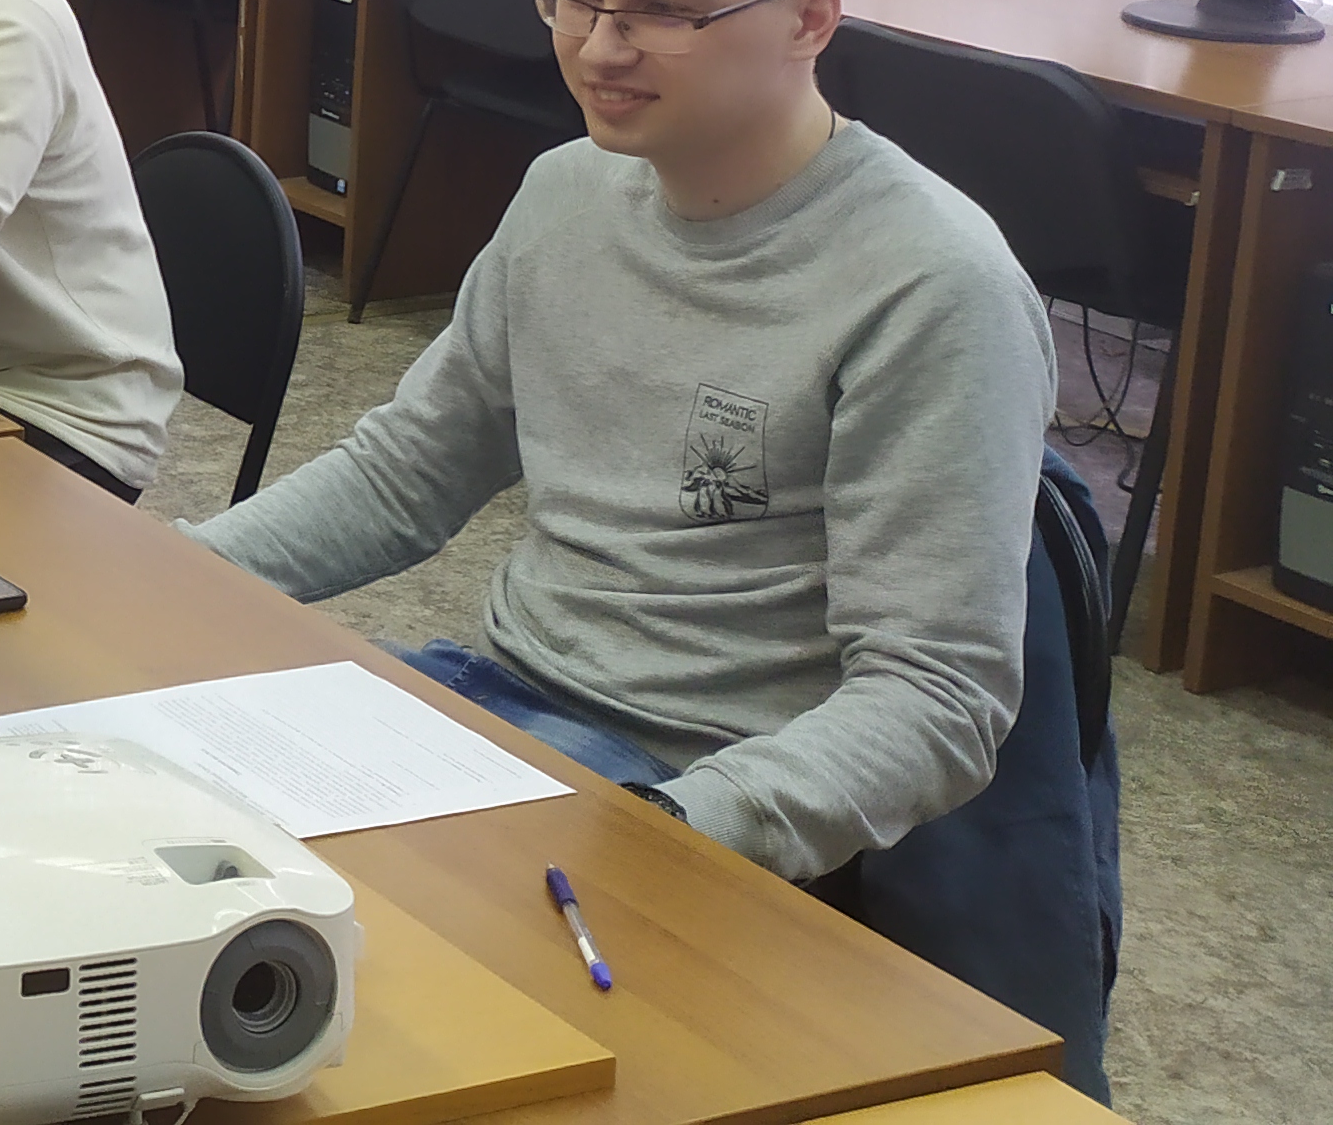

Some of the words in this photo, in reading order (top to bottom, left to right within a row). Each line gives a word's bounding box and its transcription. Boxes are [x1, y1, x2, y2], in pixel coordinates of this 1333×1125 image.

[703, 395, 757, 421] ROMANTIC
[699, 409, 719, 422] LAST
[719, 416, 755, 433] SEASON
